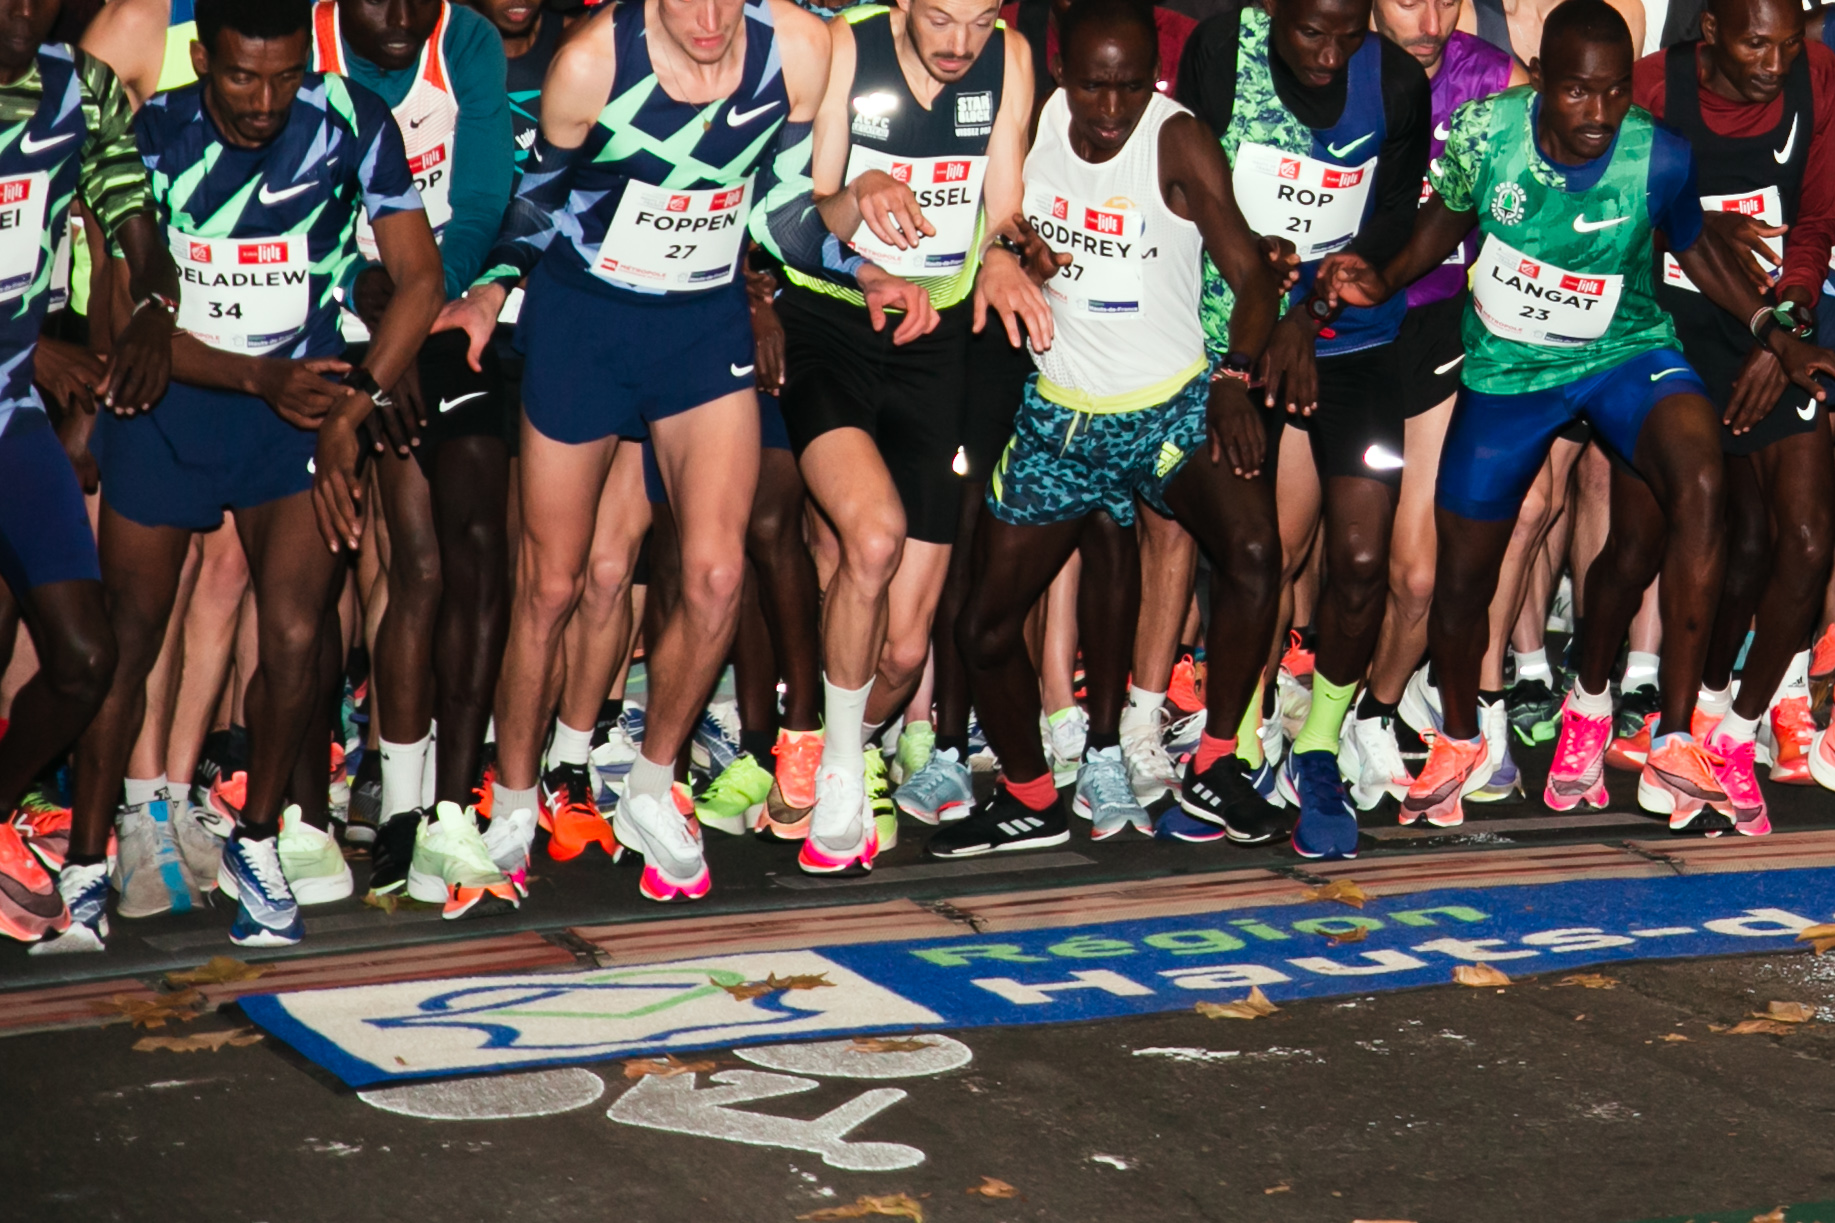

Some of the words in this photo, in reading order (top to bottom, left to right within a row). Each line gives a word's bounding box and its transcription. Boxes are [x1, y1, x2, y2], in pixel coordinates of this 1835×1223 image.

[913, 187, 972, 208] SSEL
[1277, 184, 1334, 208] ROP
[635, 209, 738, 233] FOPPEN
[1285, 216, 1312, 233] 21
[1028, 215, 1132, 259] GODFREY
[664, 244, 698, 260] 27
[1491, 265, 1599, 311] LANGAT
[208, 301, 243, 320] 34
[1519, 305, 1551, 322] 23
[909, 905, 1492, 967] Région
